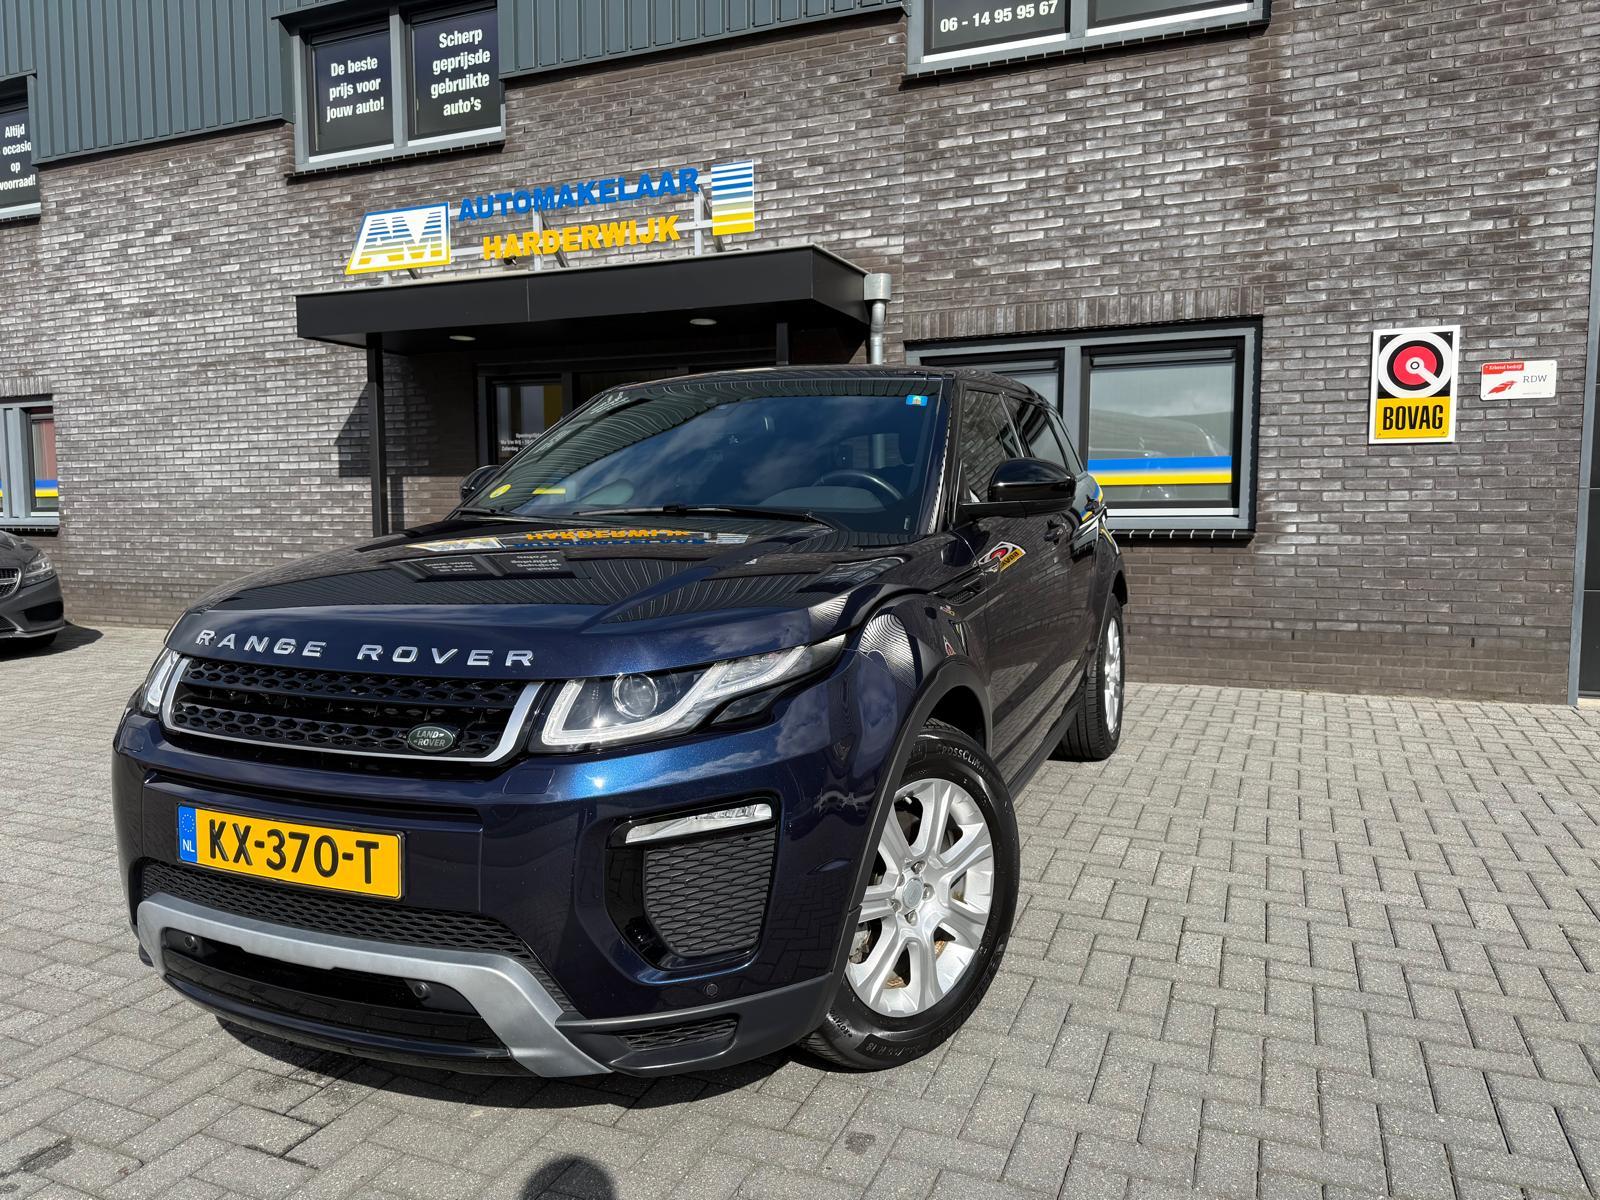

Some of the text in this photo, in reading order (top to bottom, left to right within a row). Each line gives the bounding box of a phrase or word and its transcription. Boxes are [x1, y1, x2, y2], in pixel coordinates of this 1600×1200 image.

[940, 17, 958, 33] 06
[972, 11, 991, 27] 14
[994, 7, 1012, 24] 95
[1016, 3, 1035, 19] 95
[1039, 0, 1059, 16] 67
[439, 28, 483, 49] Scherp
[330, 56, 378, 77] De beste
[432, 49, 491, 76] geprijsde
[329, 77, 382, 102] prijs voor
[430, 72, 490, 99] gebruikte
[326, 96, 385, 123] jouw auto!
[442, 96, 483, 117] auto's
[4, 123, 26, 139] Altijd
[2, 140, 32, 156] occasio
[10, 161, 21, 174] op
[458, 167, 700, 222] AUTOMAKELAAR
[482, 215, 681, 261] HARDERWIJK
[1523, 374, 1548, 384] RDW
[1382, 404, 1444, 431] BOVAG
[195, 628, 535, 668] RANGE ROVER
[416, 730, 439, 739] LAND
[417, 738, 446, 747] ROVER
[182, 839, 196, 853] NL
[208, 818, 380, 885] KX-370-T
